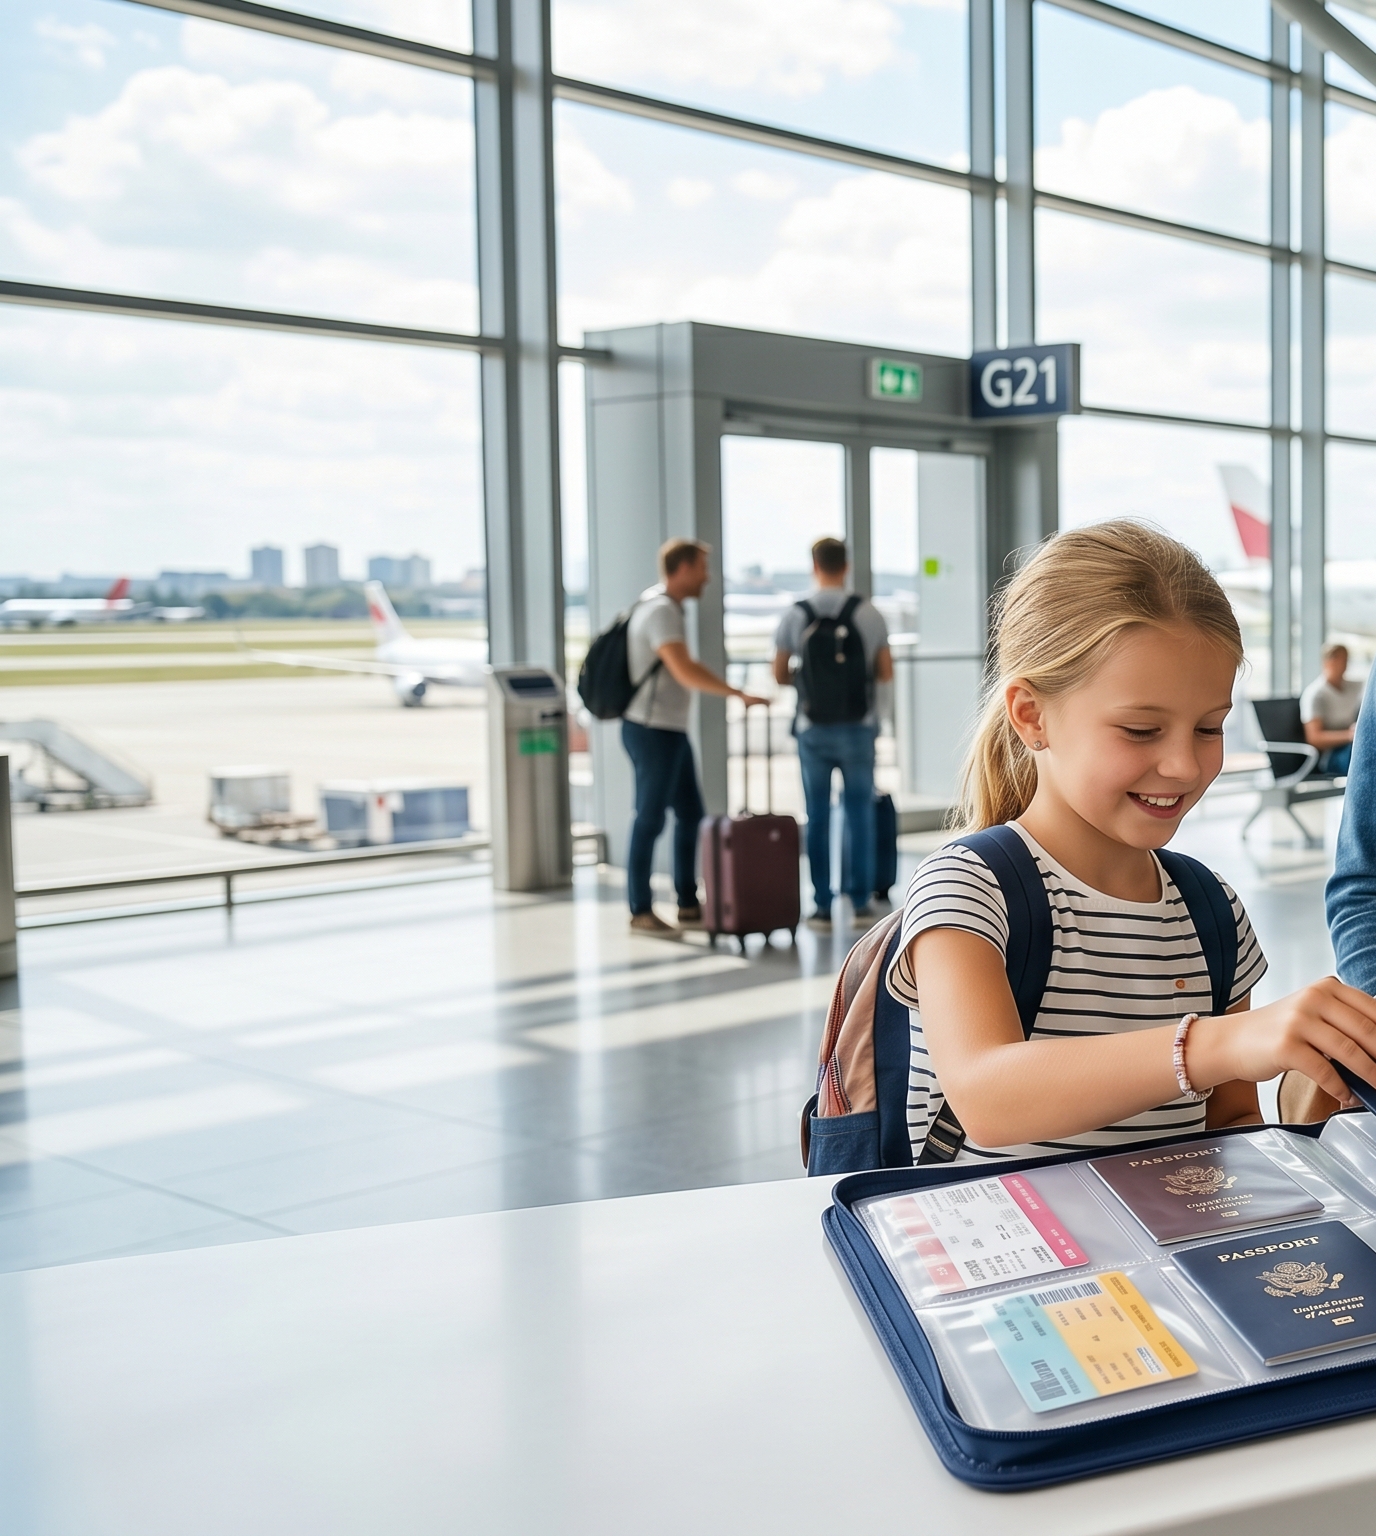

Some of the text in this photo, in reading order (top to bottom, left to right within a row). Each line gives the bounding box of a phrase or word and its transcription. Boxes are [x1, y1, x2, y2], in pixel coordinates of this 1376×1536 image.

[981, 355, 1056, 408] G21
[1128, 1146, 1222, 1168] PASSPORT
[1217, 1236, 1319, 1263] PASSPORT
